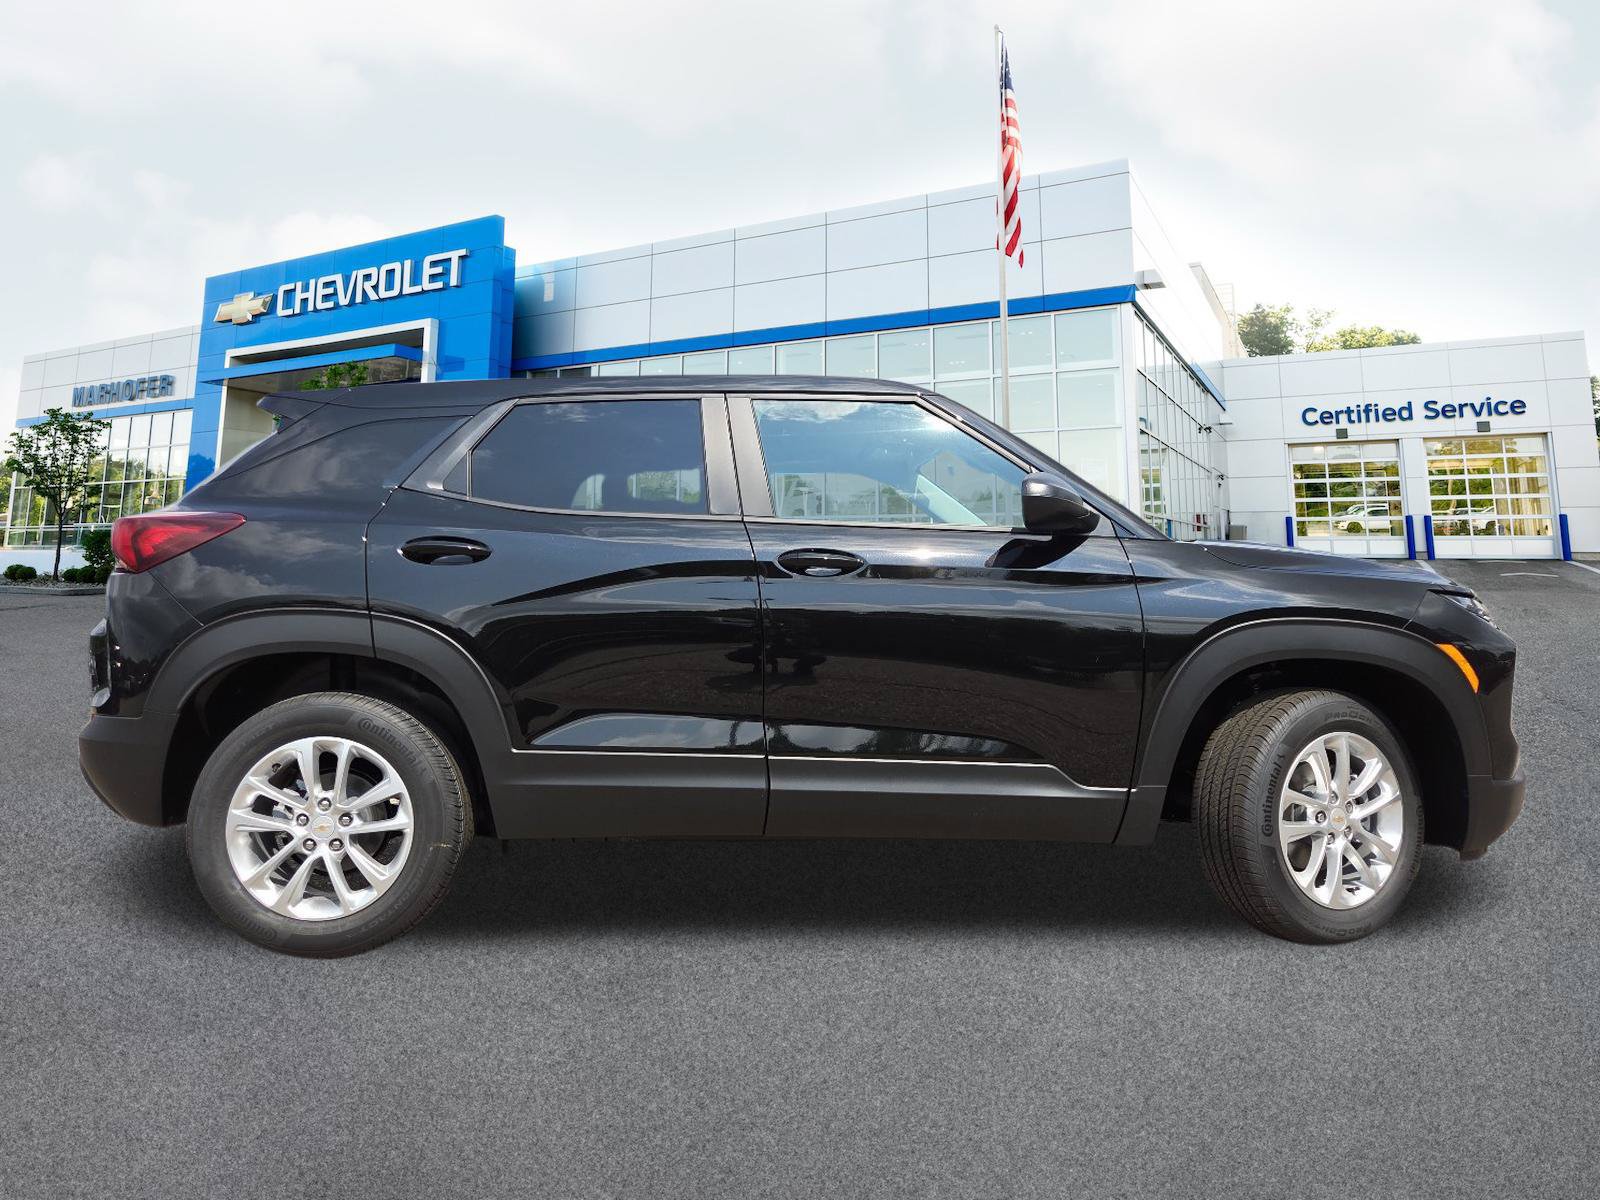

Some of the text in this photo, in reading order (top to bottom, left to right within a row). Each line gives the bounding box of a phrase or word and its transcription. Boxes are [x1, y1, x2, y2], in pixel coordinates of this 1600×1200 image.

[276, 248, 469, 317] CHEVROLET
[72, 375, 175, 407] MARHOFER
[1301, 396, 1527, 426] Certified Service
[361, 718, 420, 767] Continental
[1261, 761, 1283, 837] Continental
